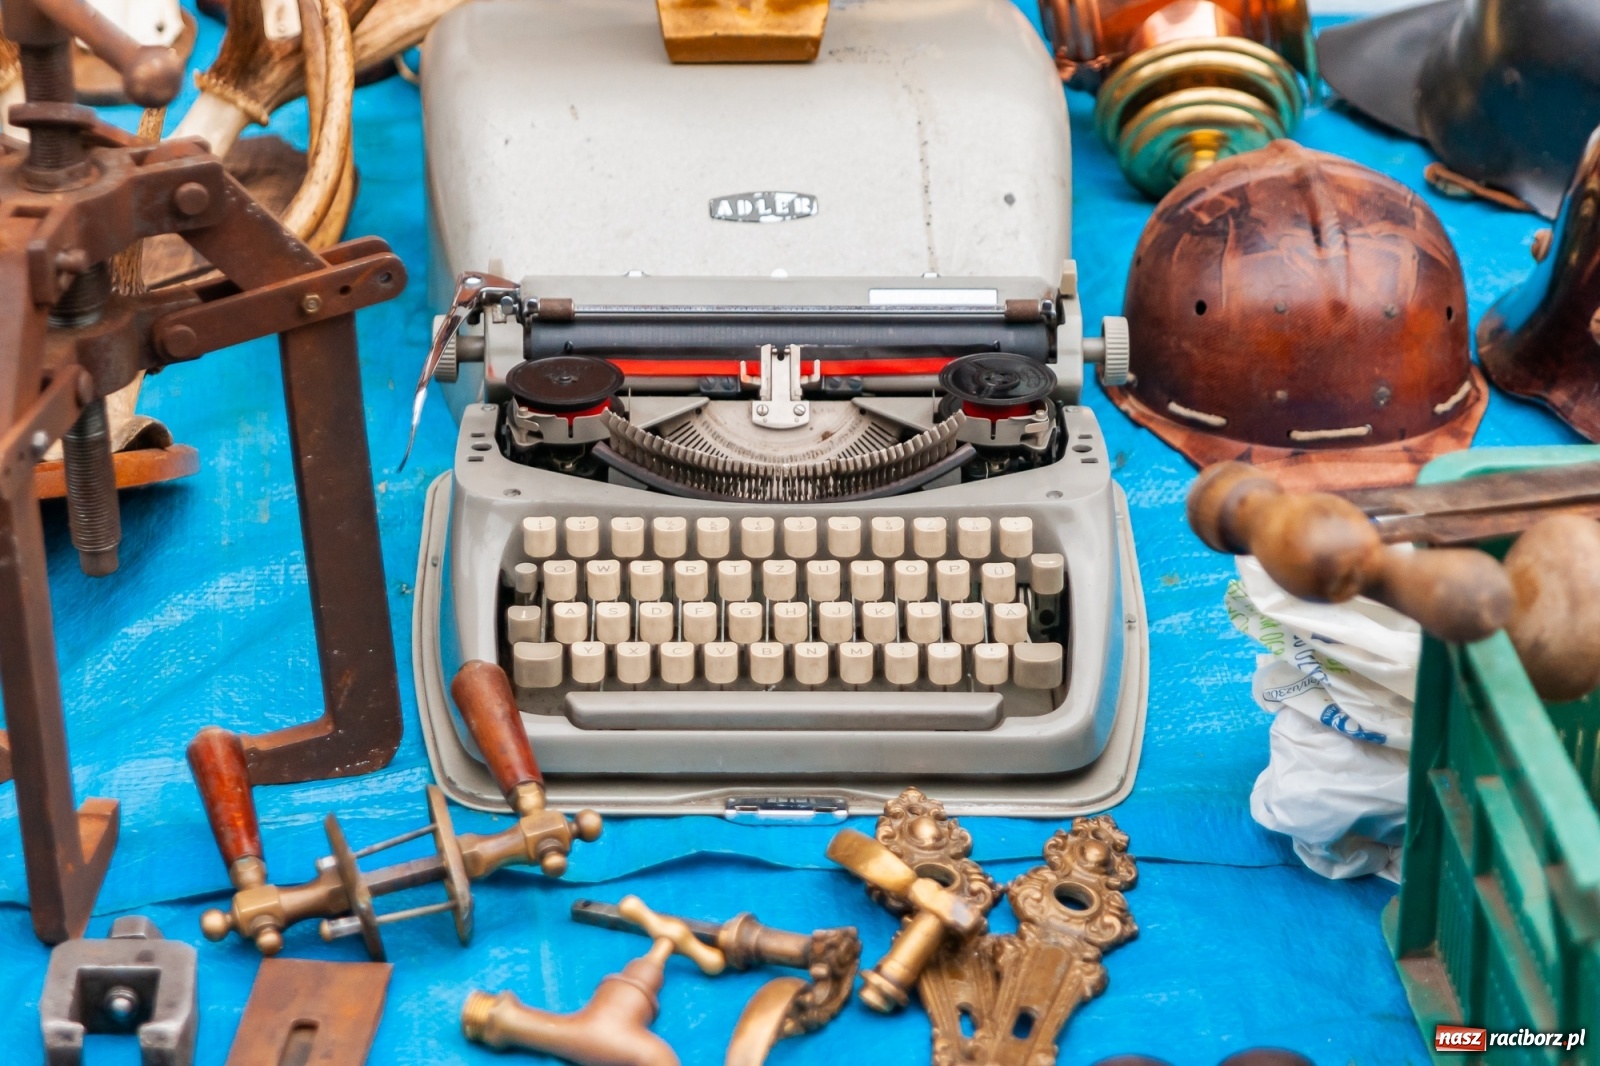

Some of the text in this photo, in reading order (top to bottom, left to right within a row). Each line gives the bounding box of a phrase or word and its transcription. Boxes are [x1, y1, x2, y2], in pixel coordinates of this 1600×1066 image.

[717, 198, 811, 216] ADLER
[642, 565, 651, 573] E
[730, 565, 740, 573] T
[775, 565, 785, 573] Z
[994, 566, 1004, 575] Ü
[608, 607, 618, 615] S
[651, 607, 662, 615] D
[695, 607, 704, 615] F
[832, 607, 841, 615] J
[962, 607, 974, 616] Ö
[1006, 607, 1017, 616] Ä
[672, 647, 682, 655] C
[716, 647, 726, 655] V
